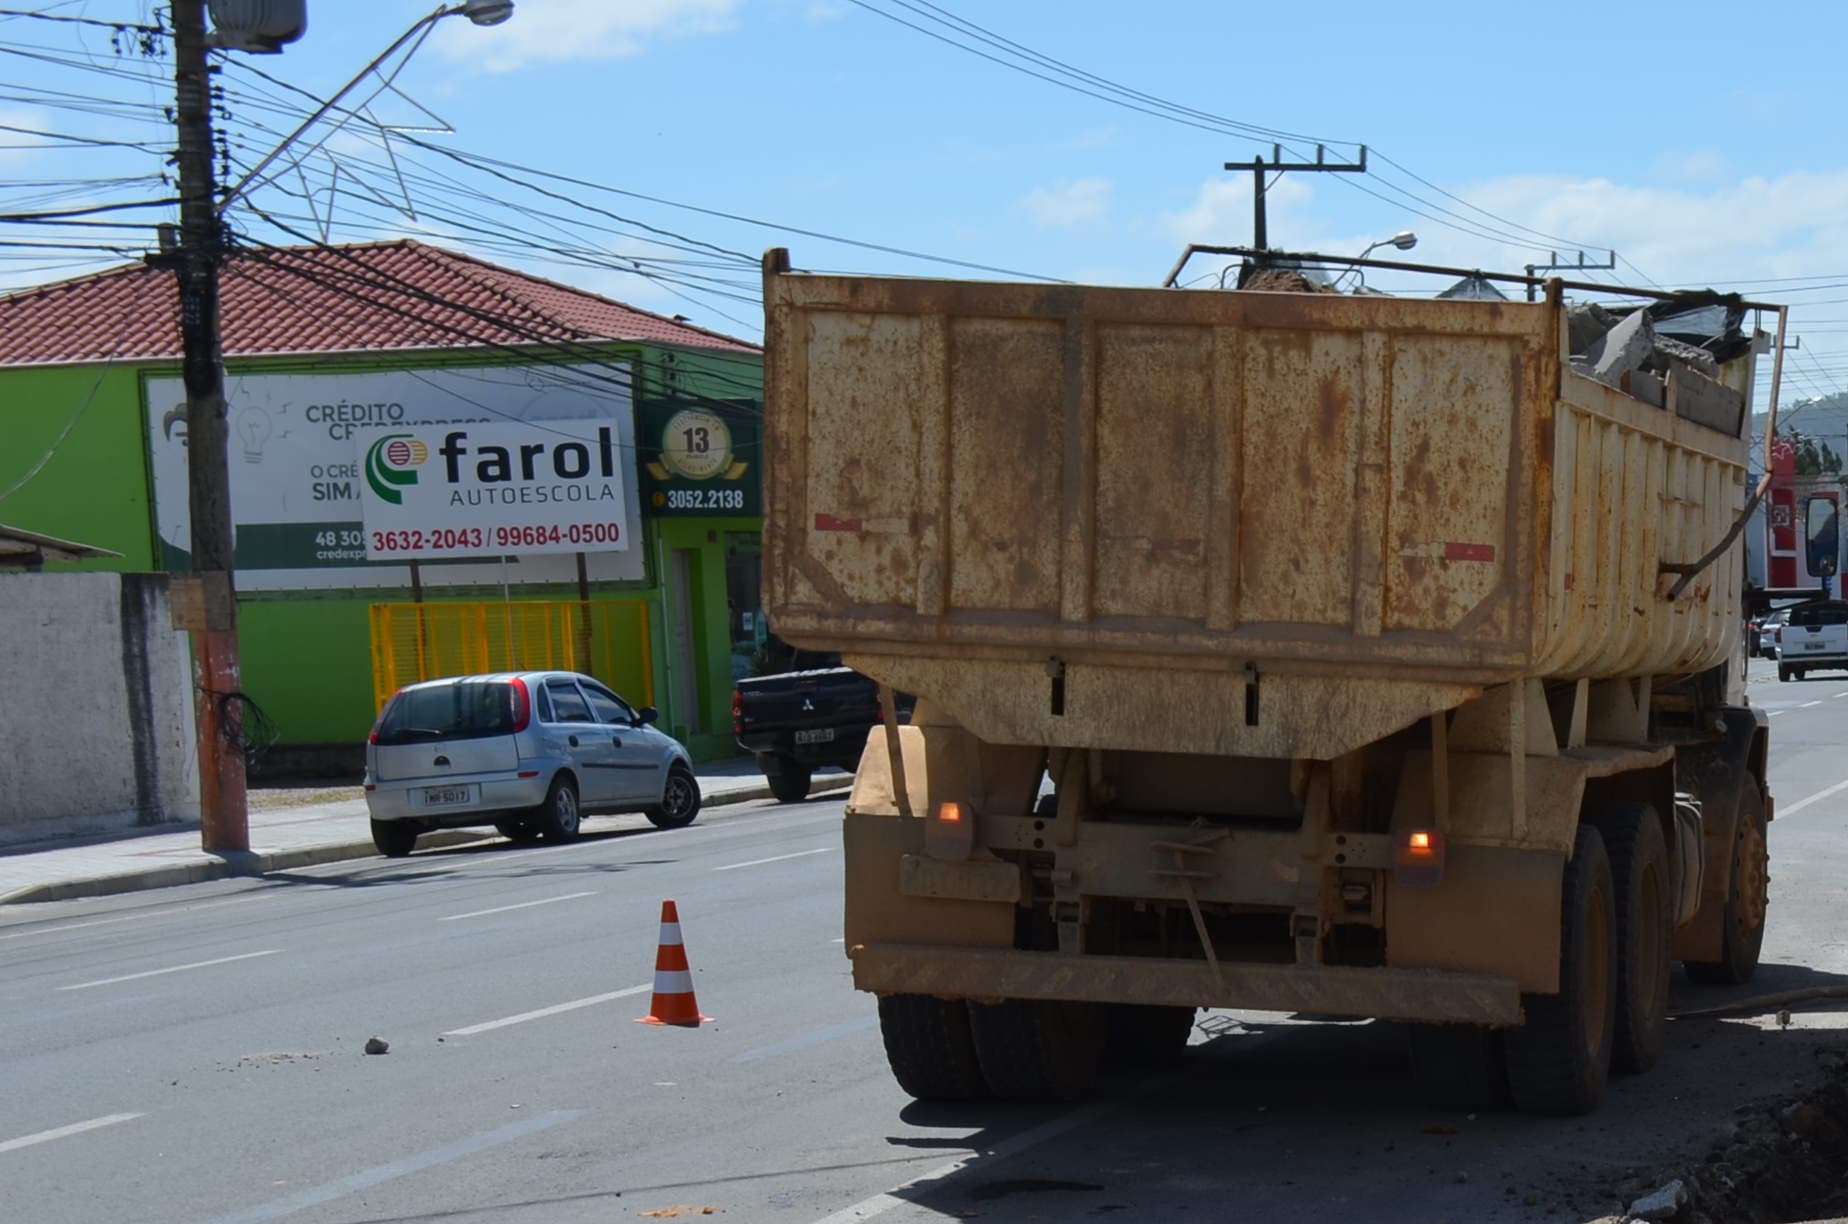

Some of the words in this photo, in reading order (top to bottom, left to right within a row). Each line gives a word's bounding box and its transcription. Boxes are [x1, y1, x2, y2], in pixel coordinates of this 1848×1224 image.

[305, 400, 404, 424] CRÉDITO
[682, 427, 710, 454] 13
[439, 426, 614, 484] farol
[312, 482, 353, 501] SIM
[450, 484, 615, 506] AUTOESCOLA
[667, 490, 743, 509] 3052.2138
[315, 531, 336, 546] 48
[373, 527, 483, 551] 3632-2043
[496, 523, 619, 547] 99684-0500
